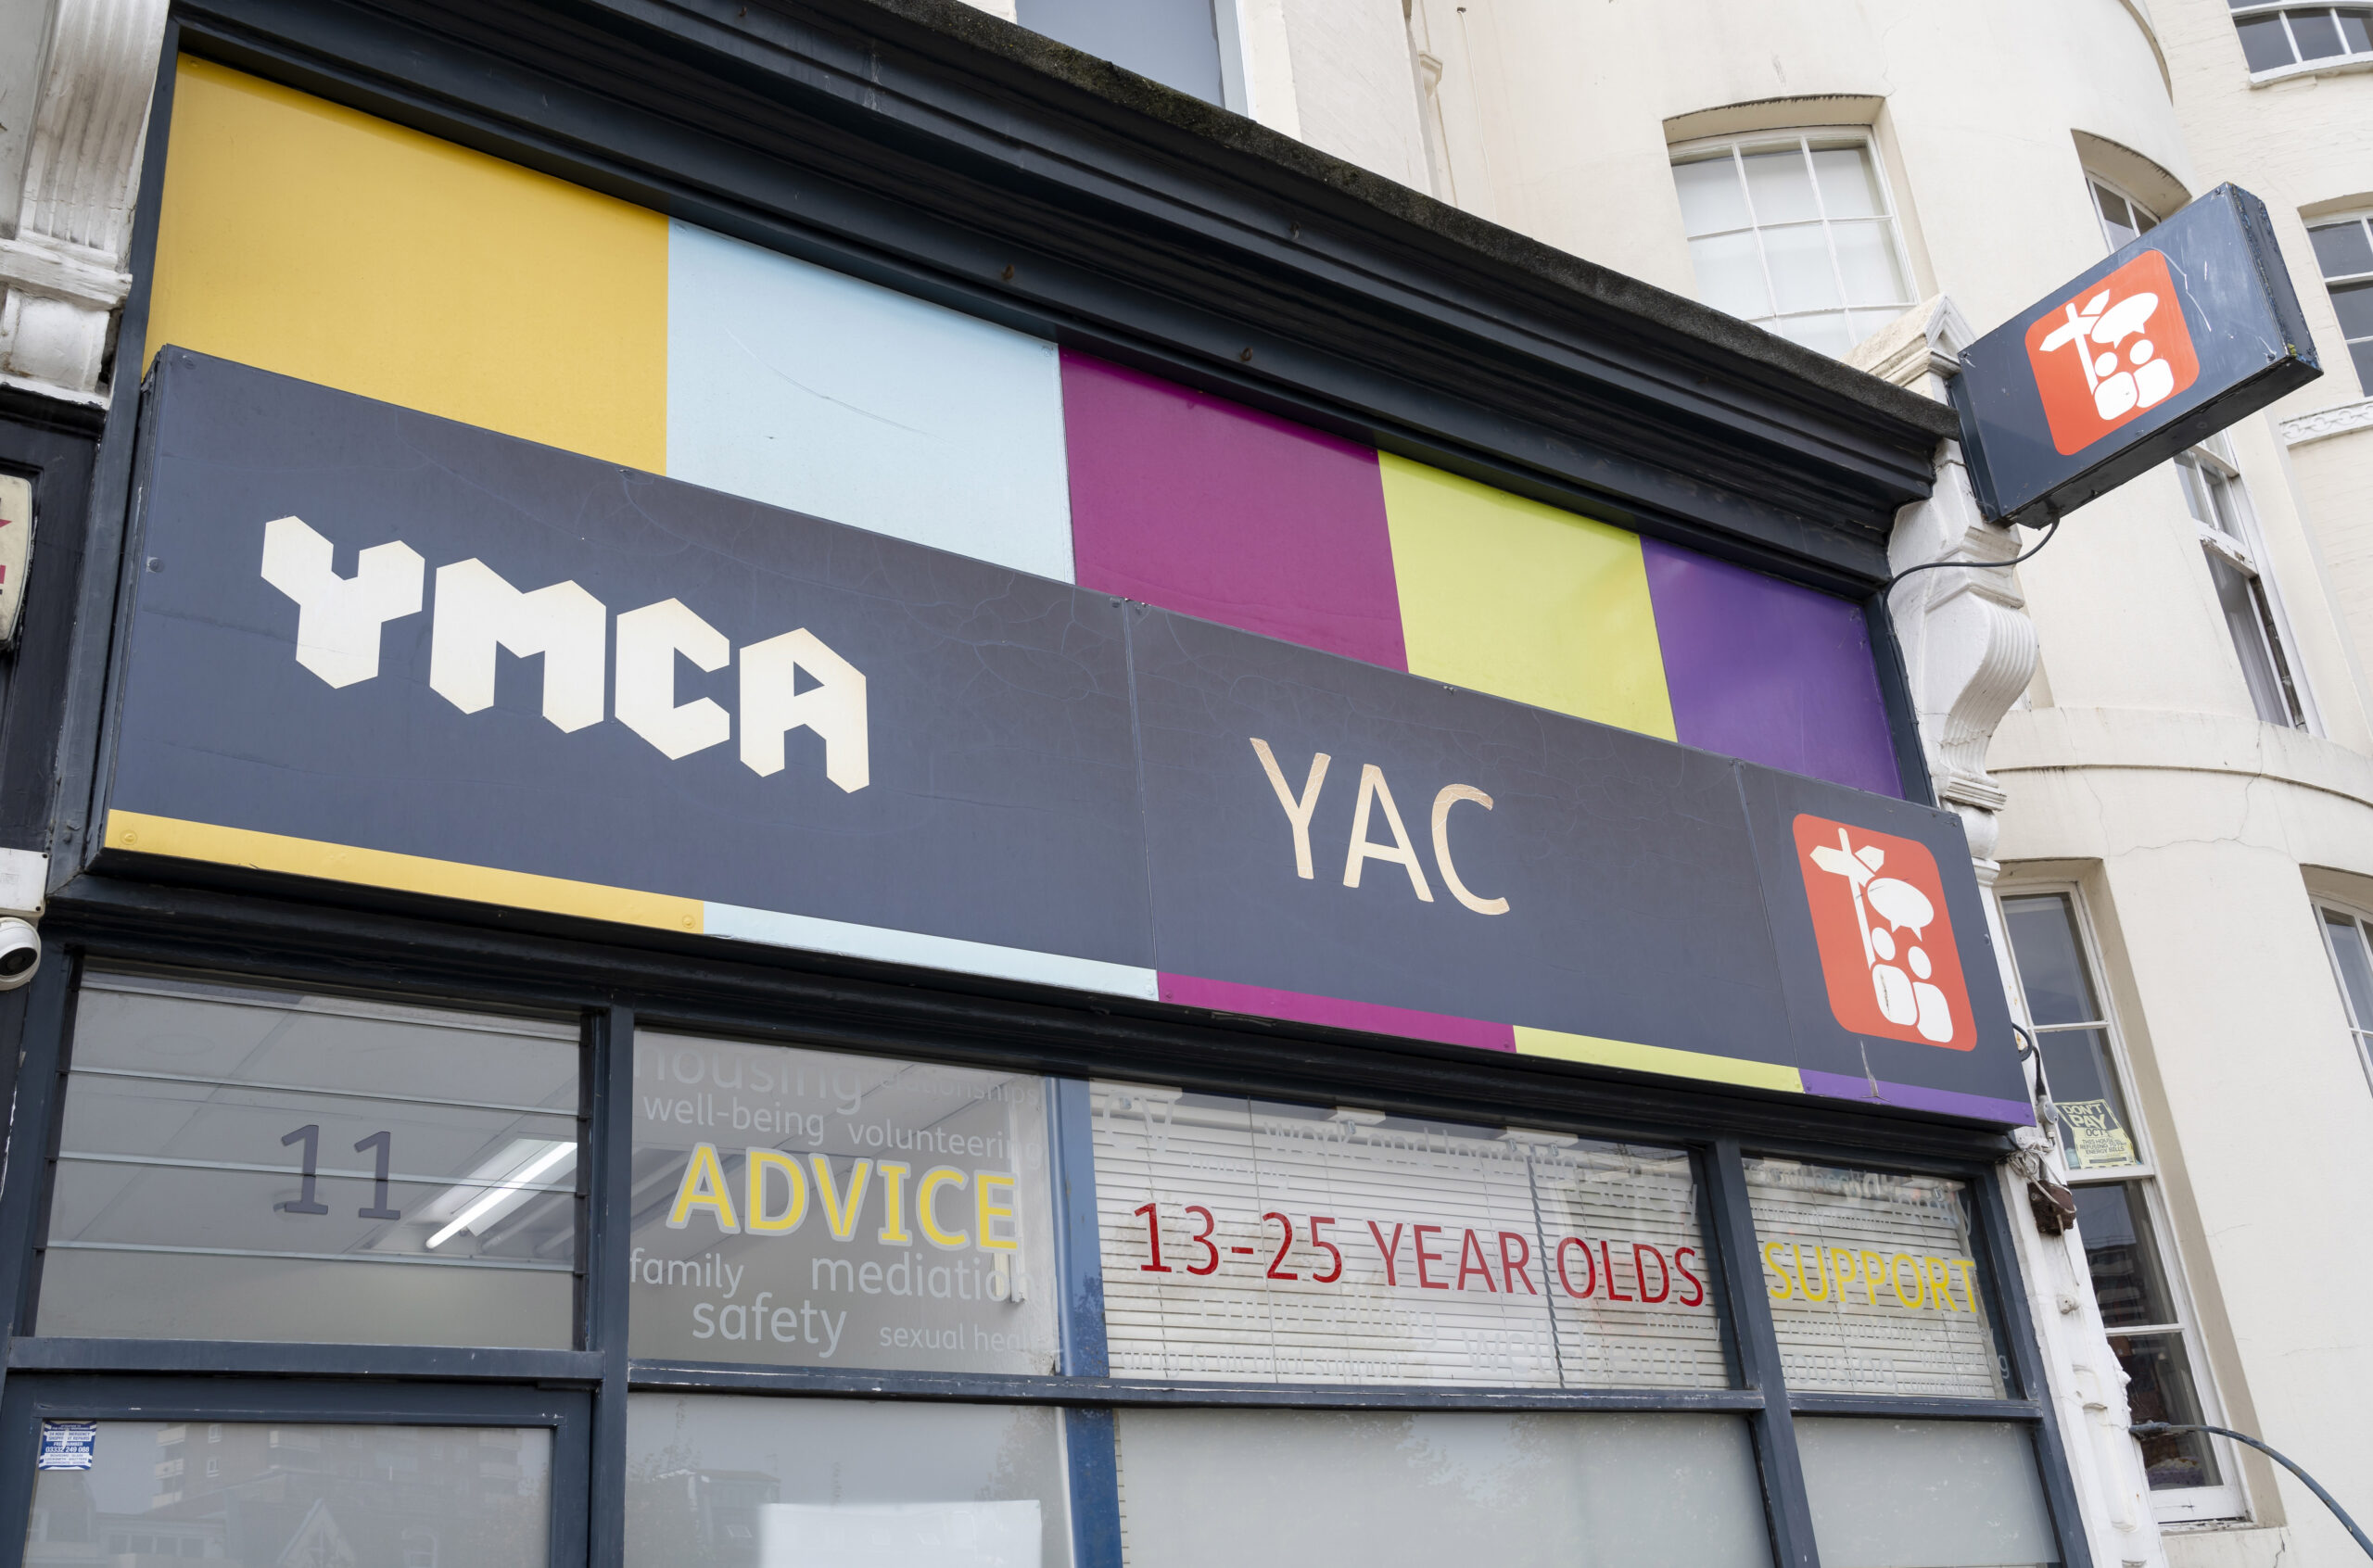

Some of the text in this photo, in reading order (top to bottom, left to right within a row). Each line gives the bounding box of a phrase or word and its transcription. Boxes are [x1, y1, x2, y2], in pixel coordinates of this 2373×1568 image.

[260, 515, 870, 794] YMCA
[1249, 737, 1510, 916] YAC
[643, 1094, 824, 1146] well-being
[1102, 1092, 1175, 1151] CV
[1263, 1118, 1355, 1161] work
[2061, 1103, 2102, 1115] DON'T
[2067, 1114, 2107, 1130] PAY
[281, 1124, 401, 1220] 11
[666, 1142, 1020, 1254] ADVICE
[629, 1247, 1034, 1303] family mediation
[1133, 1202, 1706, 1308] 13-25 YEAR OLDS
[1762, 1239, 1978, 1314] SUPPORT
[692, 1293, 847, 1359] safety
[879, 1322, 965, 1351] sexual
[1461, 1318, 1702, 1388] well-being
